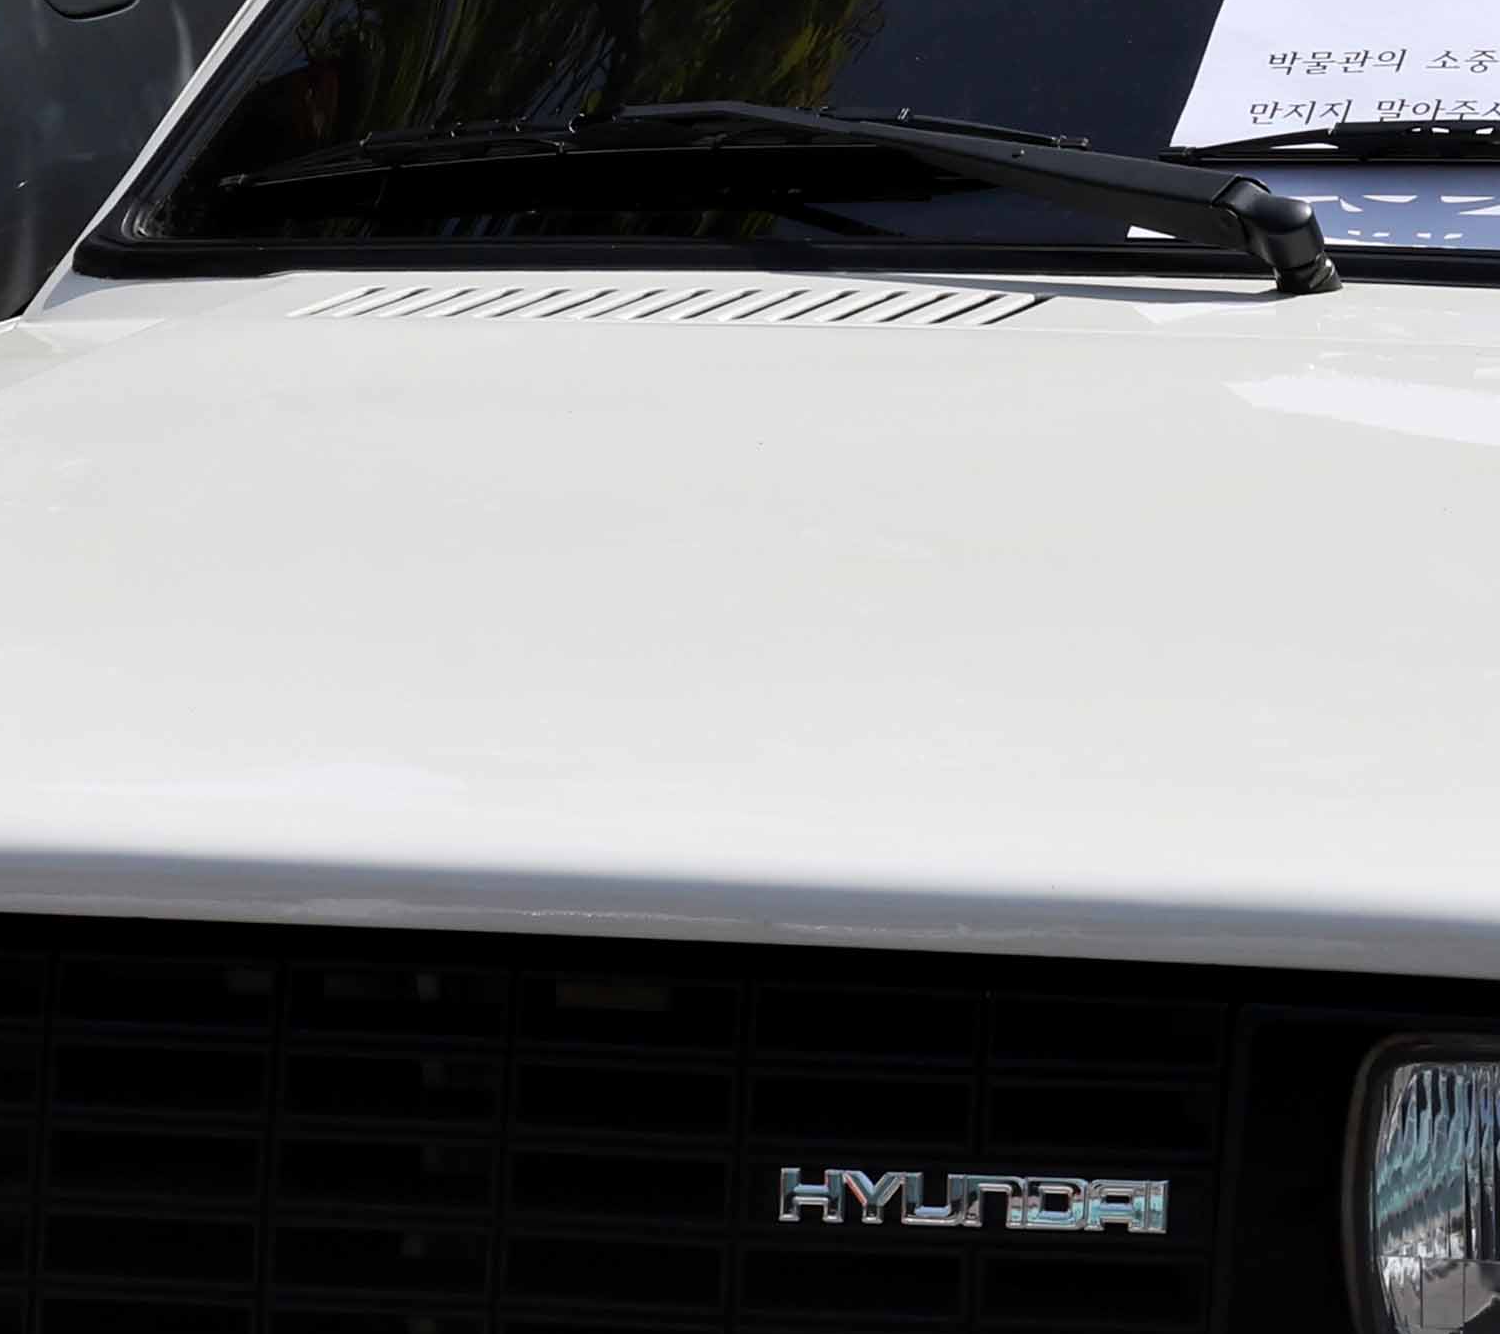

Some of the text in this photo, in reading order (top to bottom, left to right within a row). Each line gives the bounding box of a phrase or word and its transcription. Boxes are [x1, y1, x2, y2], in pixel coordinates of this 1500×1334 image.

[1267, 48, 1408, 76] 박물관의
[1248, 98, 1354, 126] 만지지
[778, 1167, 1169, 1234] HYUNDAI
